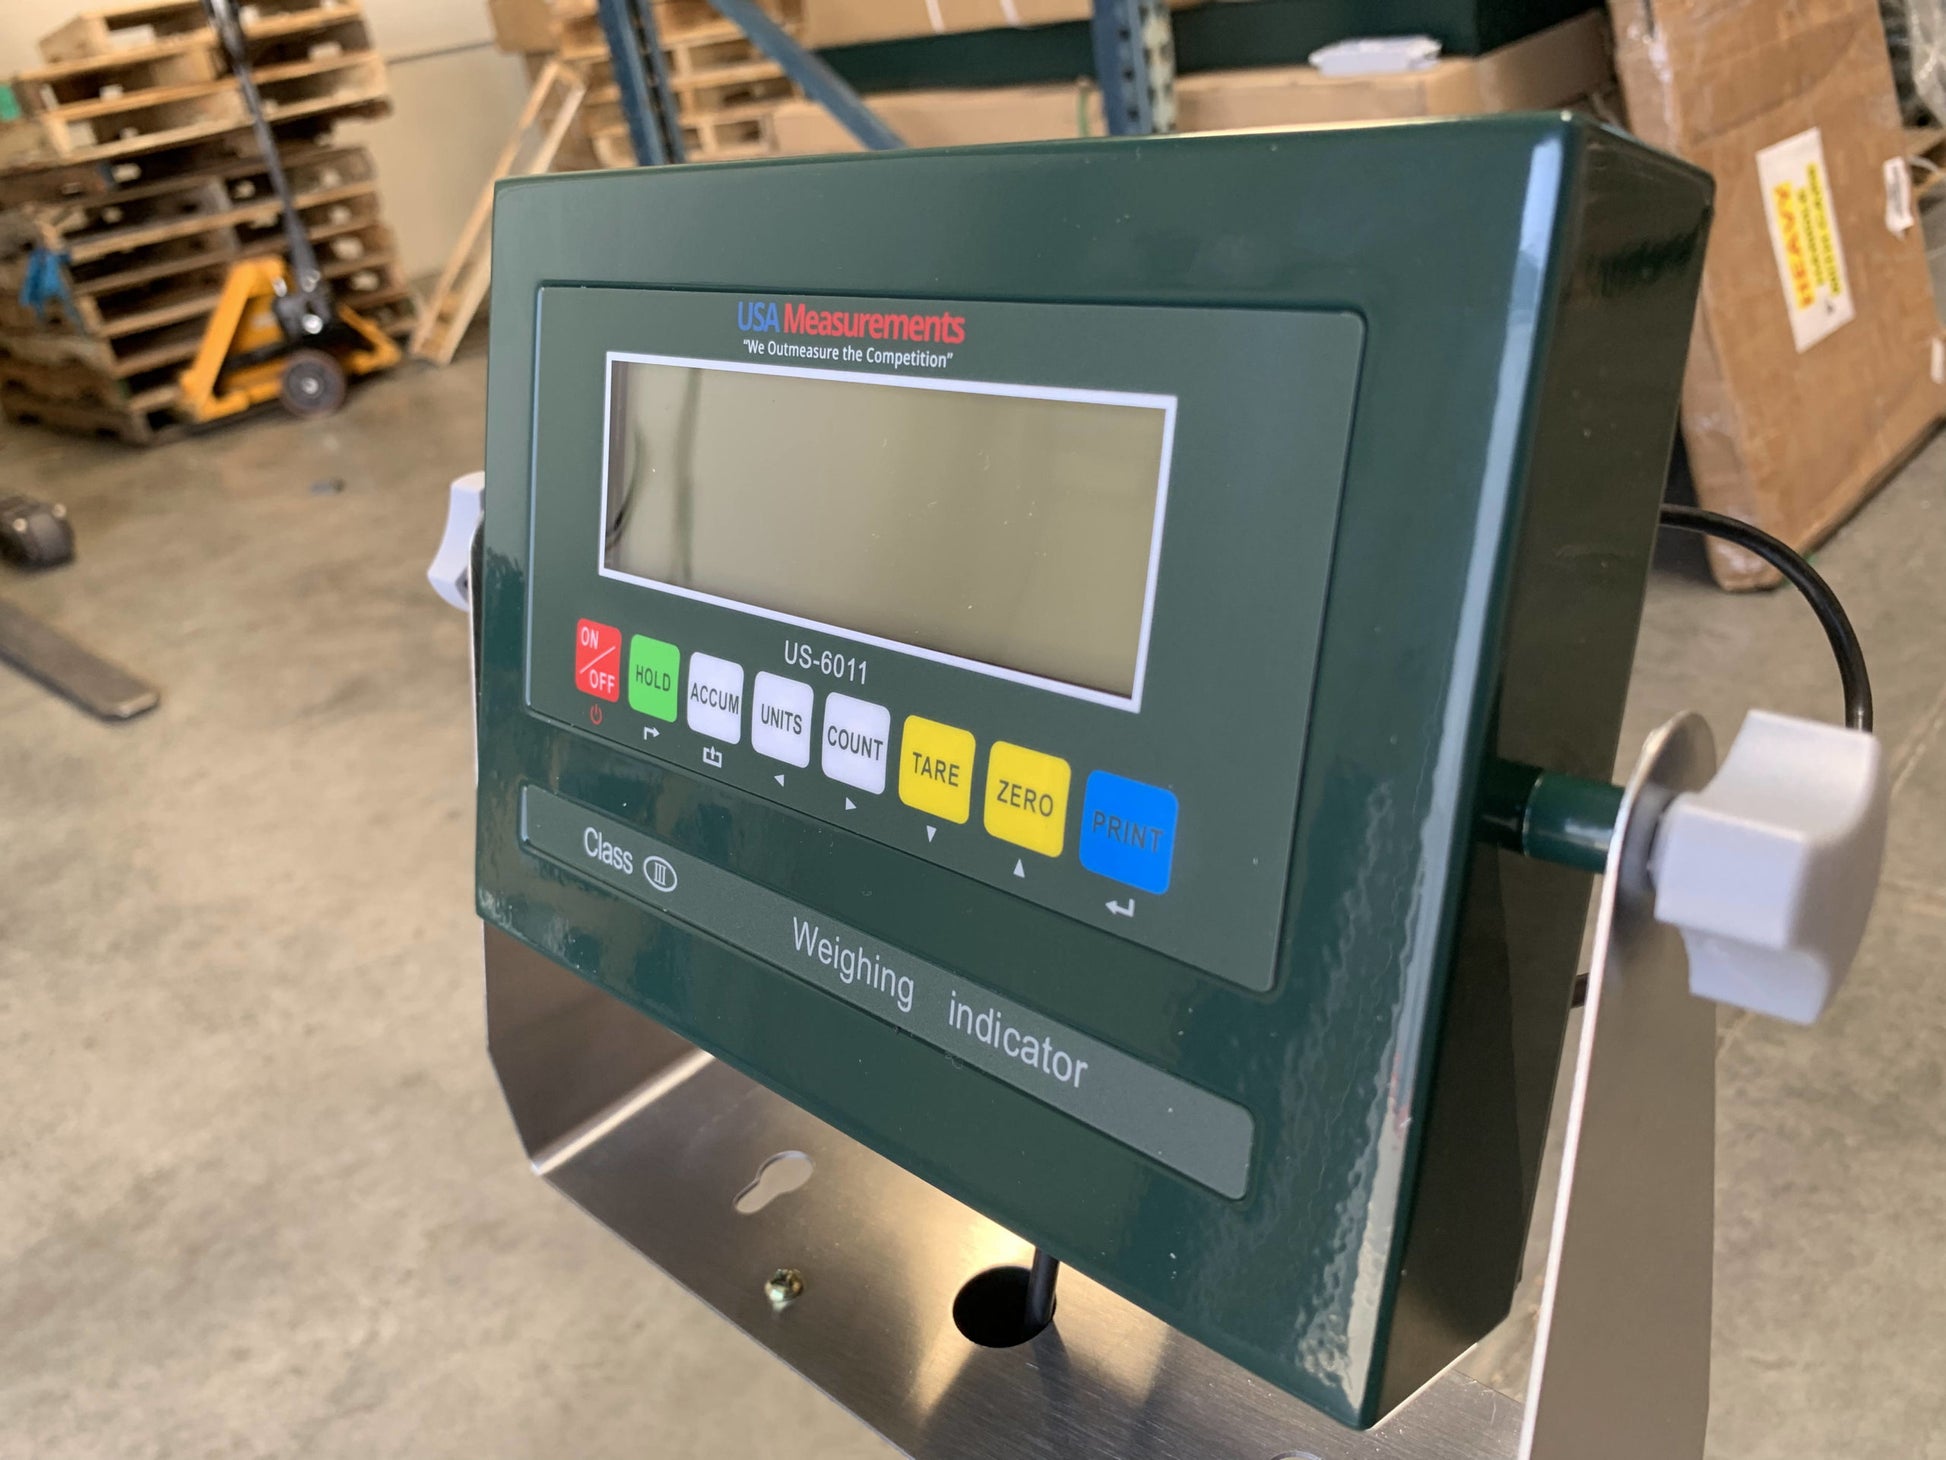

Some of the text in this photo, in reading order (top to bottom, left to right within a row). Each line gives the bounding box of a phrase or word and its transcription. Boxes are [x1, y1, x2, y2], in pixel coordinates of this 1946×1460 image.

[737, 301, 966, 344] USA Measurements
[743, 339, 953, 370] “We Outmeasure the Competition”
[580, 626, 600, 650] ON
[636, 664, 671, 692] HOLD
[784, 640, 867, 685] US-6011
[589, 671, 615, 695] OFF
[690, 682, 740, 715] ACCUM
[760, 703, 803, 735] UNITS
[826, 725, 884, 761] COUNT
[912, 752, 960, 787] TARE
[996, 780, 1054, 818] ZERO
[1092, 810, 1164, 852] PRINT
[583, 826, 634, 876] Class
[792, 916, 1089, 1088] Weighing indicator
